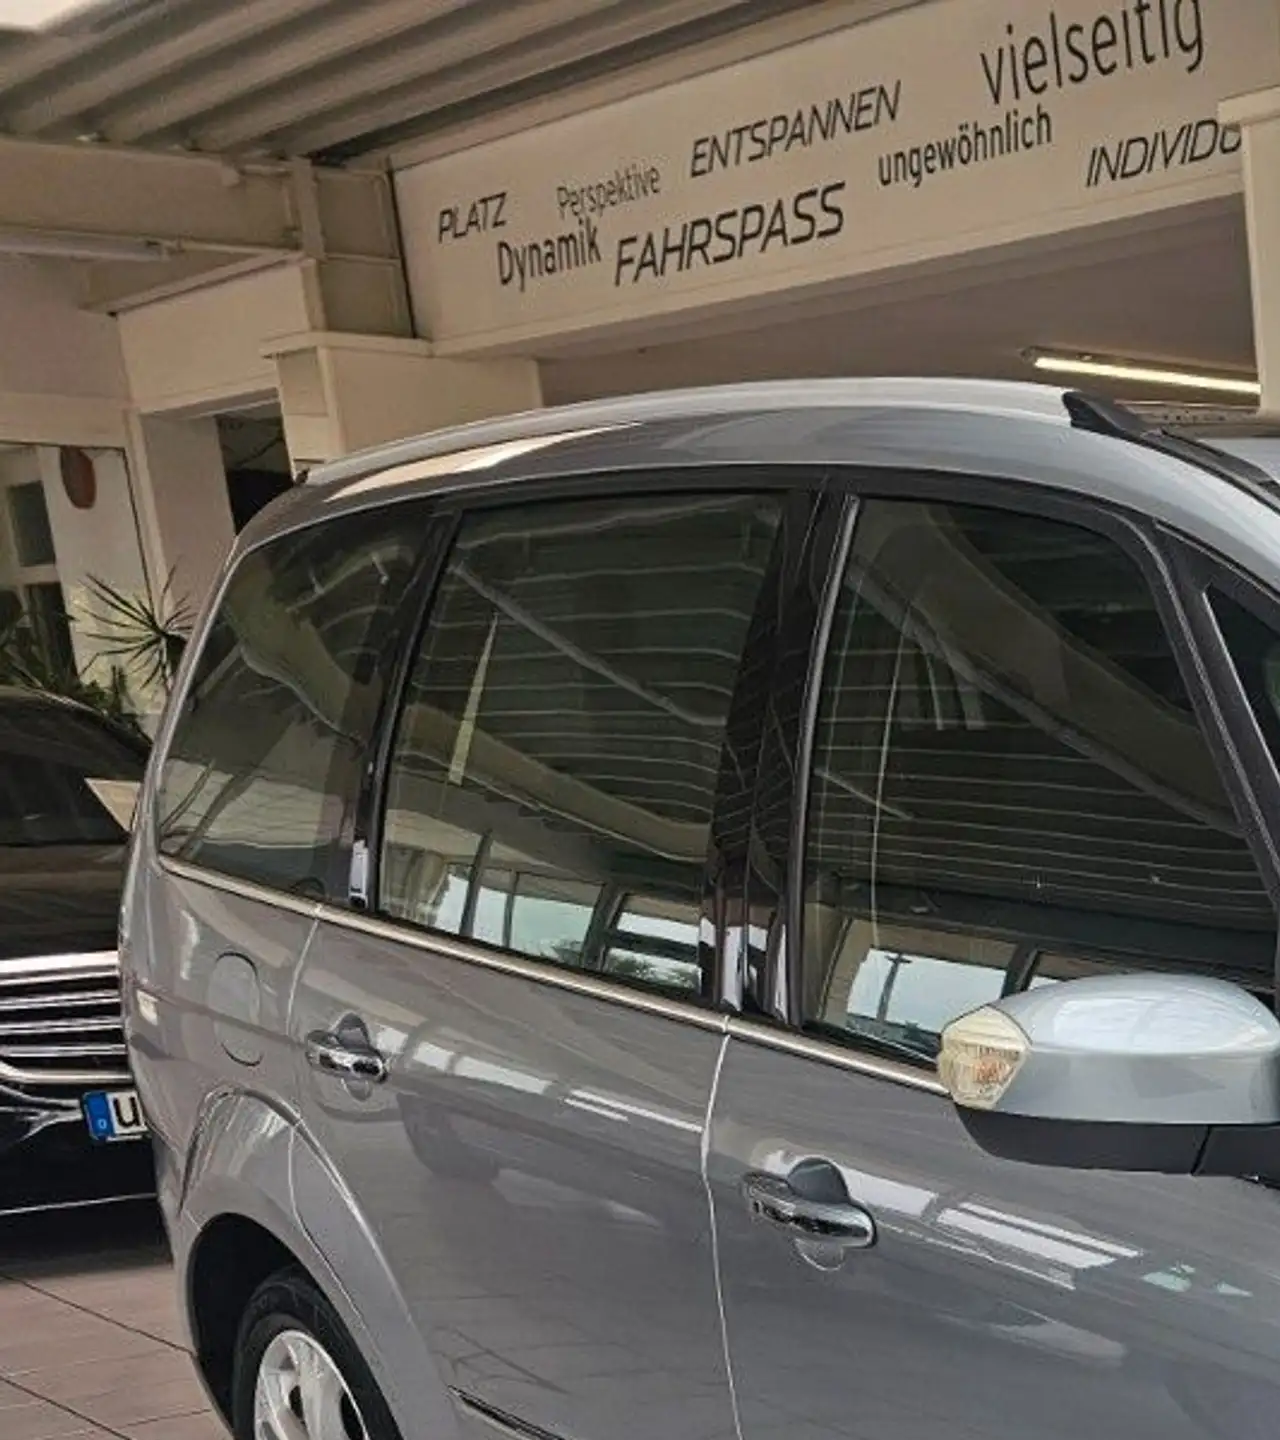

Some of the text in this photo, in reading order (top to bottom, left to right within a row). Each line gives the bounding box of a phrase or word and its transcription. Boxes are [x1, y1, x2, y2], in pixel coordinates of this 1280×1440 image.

[690, 79, 901, 178] ENTSPANNEN
[878, 103, 1052, 188] ungewöhnlich
[437, 192, 507, 243] PLATZ
[556, 165, 660, 219] Perspektive
[496, 217, 602, 292] Dynamik
[613, 182, 847, 287] FAHRSPASS
